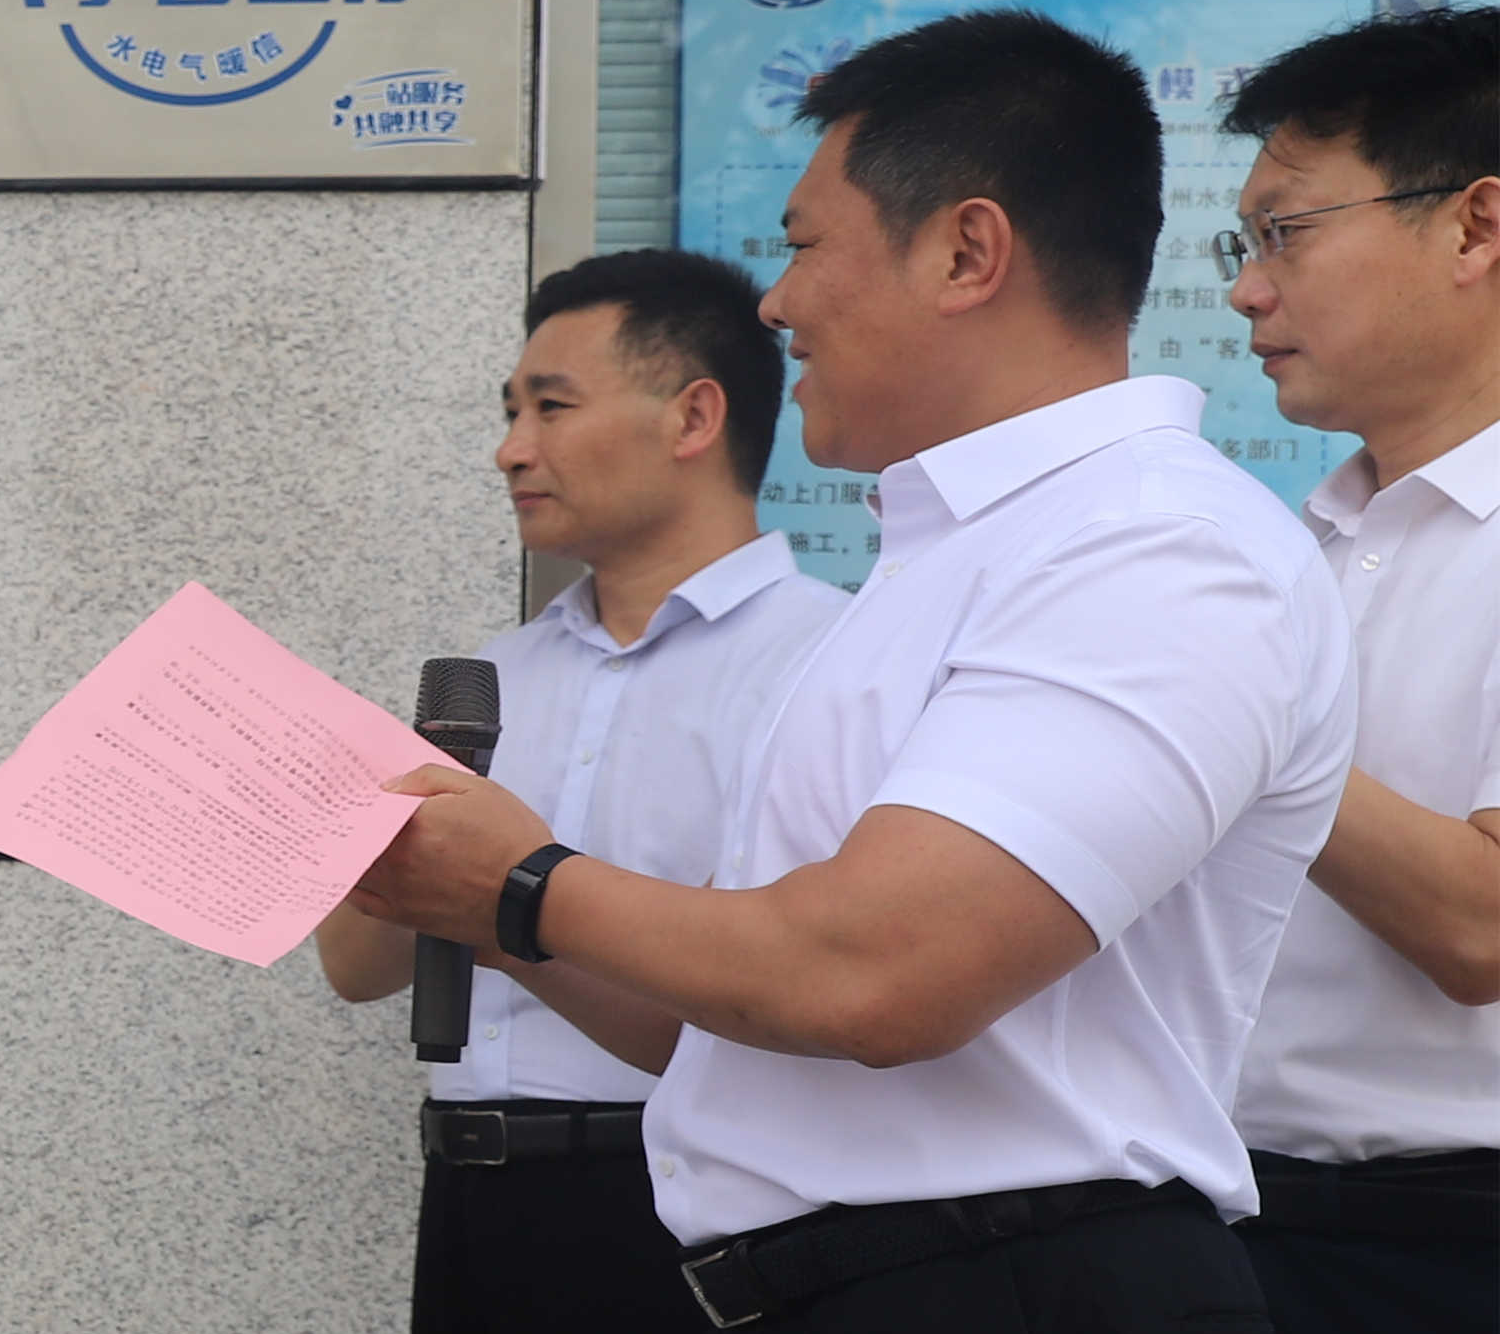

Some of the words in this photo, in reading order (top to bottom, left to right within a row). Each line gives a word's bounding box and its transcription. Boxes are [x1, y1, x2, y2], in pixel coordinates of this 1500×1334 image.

[106, 30, 284, 81] 水电气暖信
